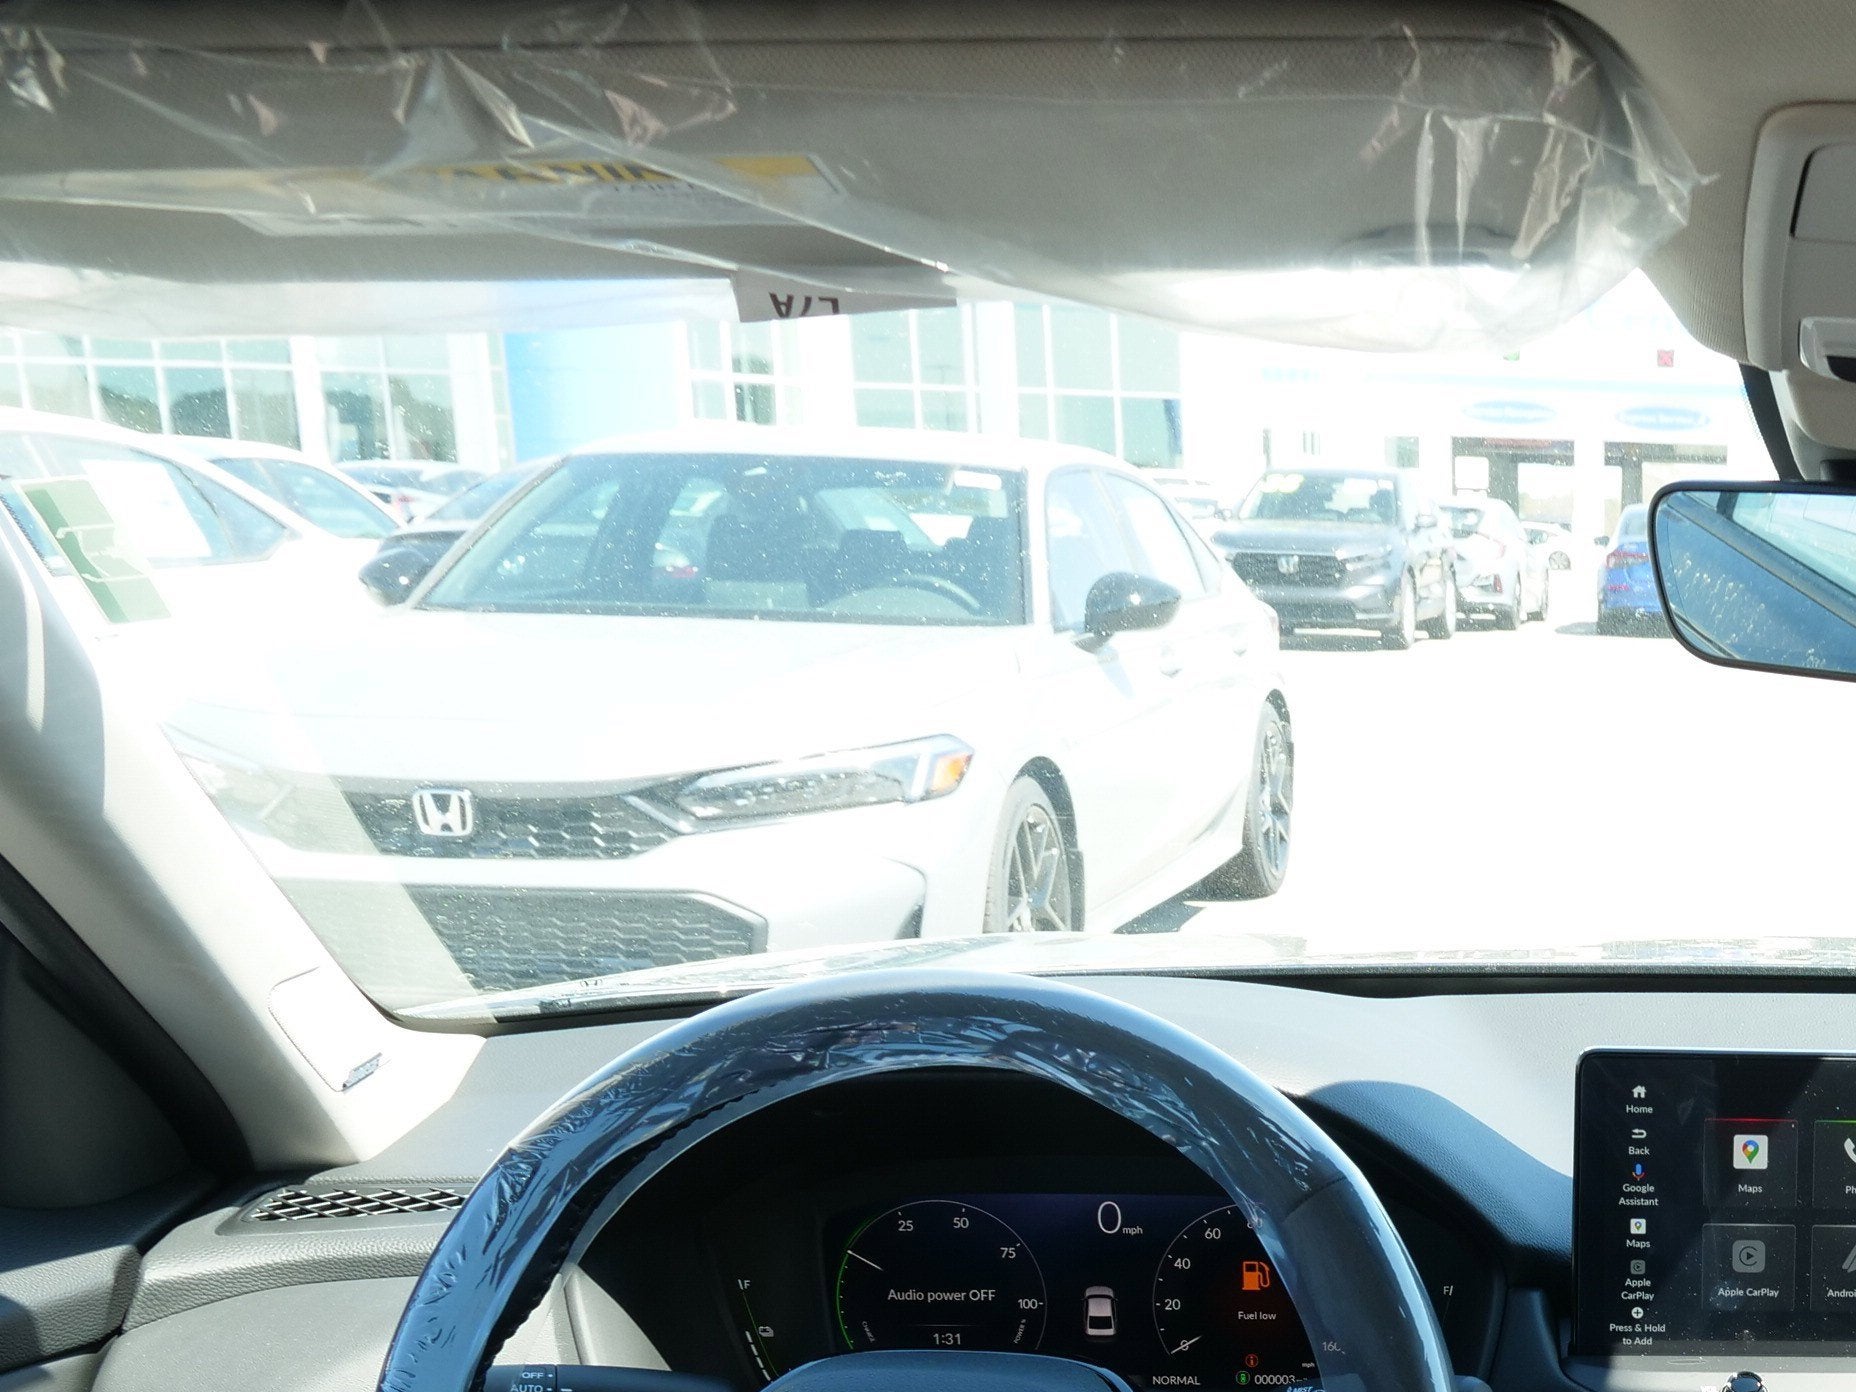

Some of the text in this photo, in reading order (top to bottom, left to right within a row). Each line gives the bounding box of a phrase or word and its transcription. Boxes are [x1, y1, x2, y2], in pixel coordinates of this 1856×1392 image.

[1626, 1105, 1653, 1113] Home
[1628, 1146, 1650, 1155] Back
[1622, 1184, 1654, 1195] Google
[1738, 1184, 1762, 1195] Maps
[1619, 1197, 1658, 1206] Assistant
[953, 1217, 969, 1228] 50
[1098, 1201, 1143, 1235] 0 mph
[898, 1221, 913, 1231] 25
[1205, 1228, 1221, 1239] 60
[1626, 1240, 1650, 1249] Maps
[1000, 1248, 1016, 1259] 75
[1174, 1258, 1191, 1270] 40
[1625, 1279, 1651, 1288] Apple
[888, 1289, 995, 1303] Audio power OFF
[1621, 1292, 1654, 1301] CarPlay
[1718, 1288, 1779, 1298] Apple CarPlay
[1018, 1299, 1038, 1309] 100
[1165, 1298, 1181, 1310] 20
[1238, 1312, 1276, 1320] Fuel low
[1609, 1324, 1665, 1333] Press & Hold
[933, 1333, 961, 1345] 1:31
[1633, 1337, 1652, 1346] Add
[1153, 1376, 1201, 1386] NORMAL
